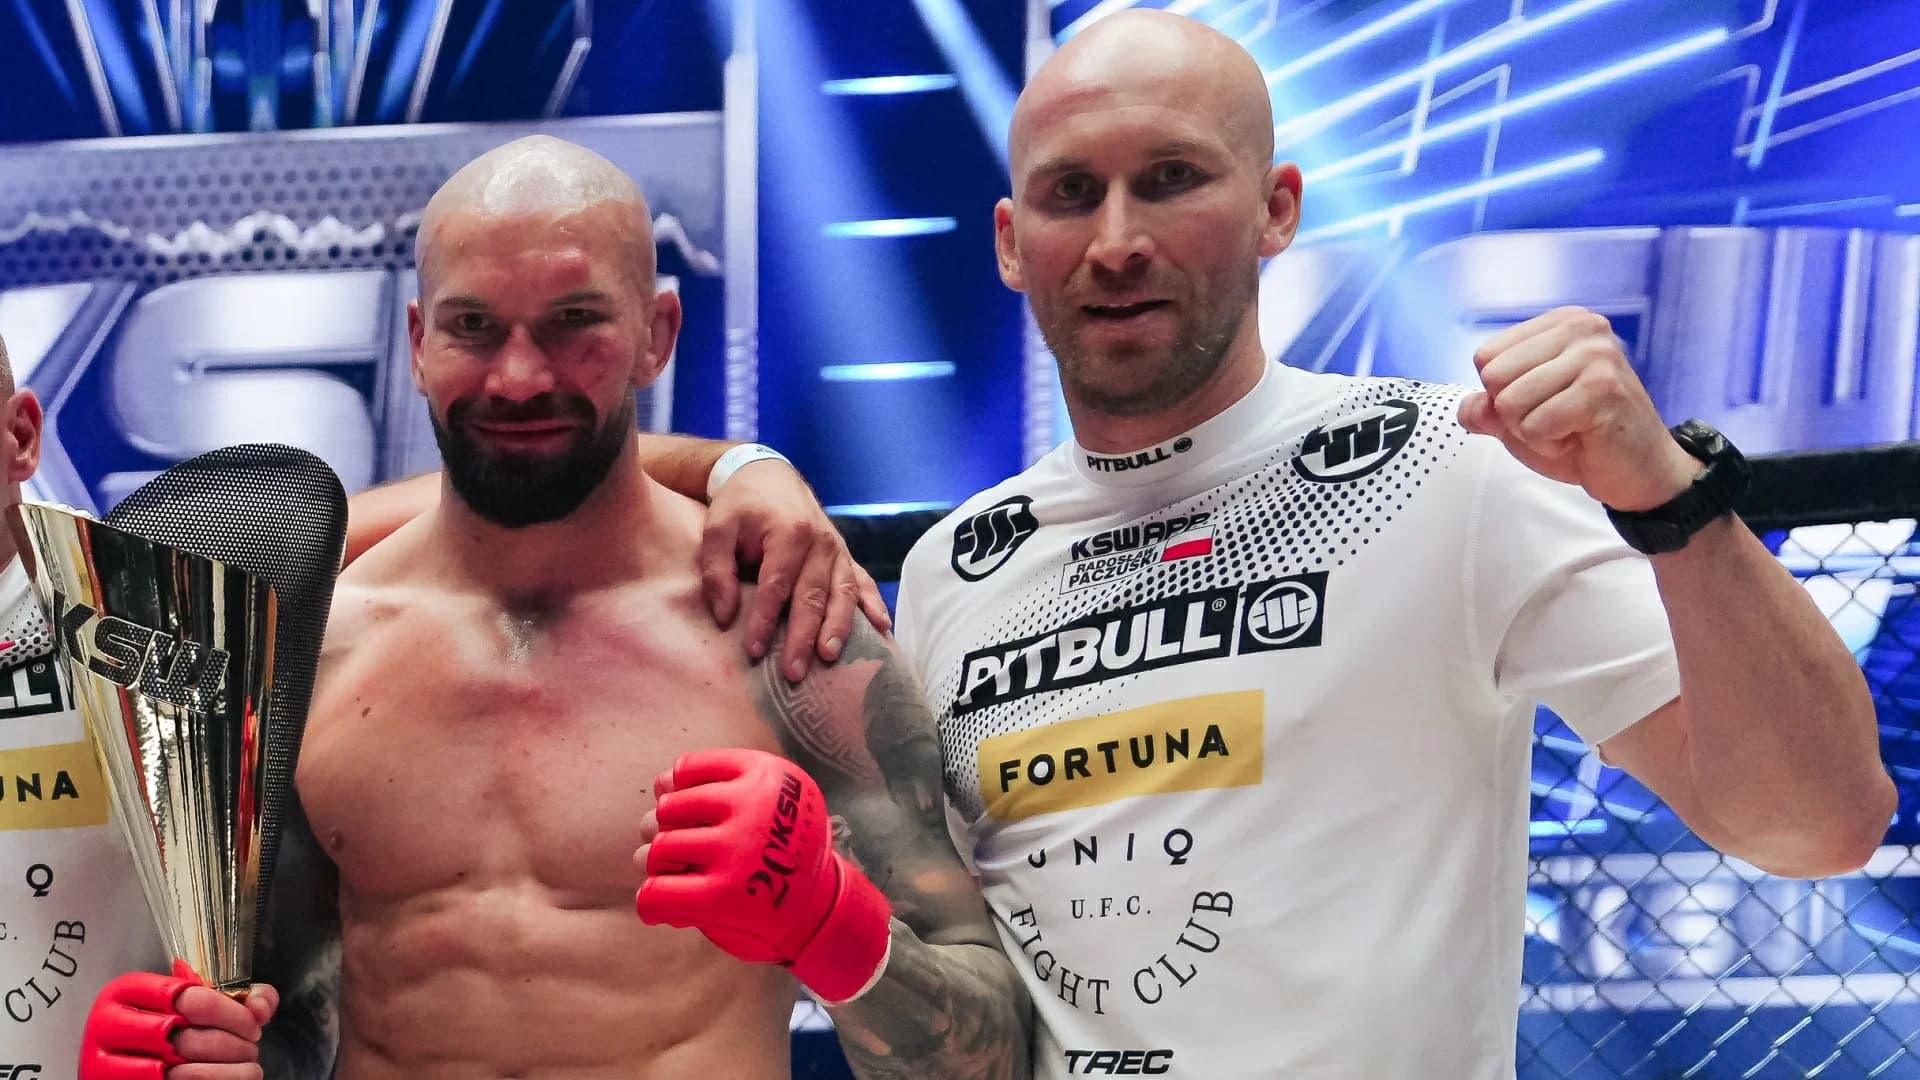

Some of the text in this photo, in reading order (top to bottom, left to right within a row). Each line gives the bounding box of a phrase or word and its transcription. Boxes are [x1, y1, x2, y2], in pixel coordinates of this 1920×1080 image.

[1087, 448, 1171, 472] PITBULL
[1069, 551, 1158, 587] PACZUSKI
[53, 589, 230, 714] KSW
[1000, 724, 1229, 792] FORTUNA
[1071, 895, 1151, 919] U.F.C.
[5, 919, 87, 1024] CLUB
[1010, 891, 1233, 1015] FIGHT CLUB
[1064, 1049, 1174, 1075] TREC
